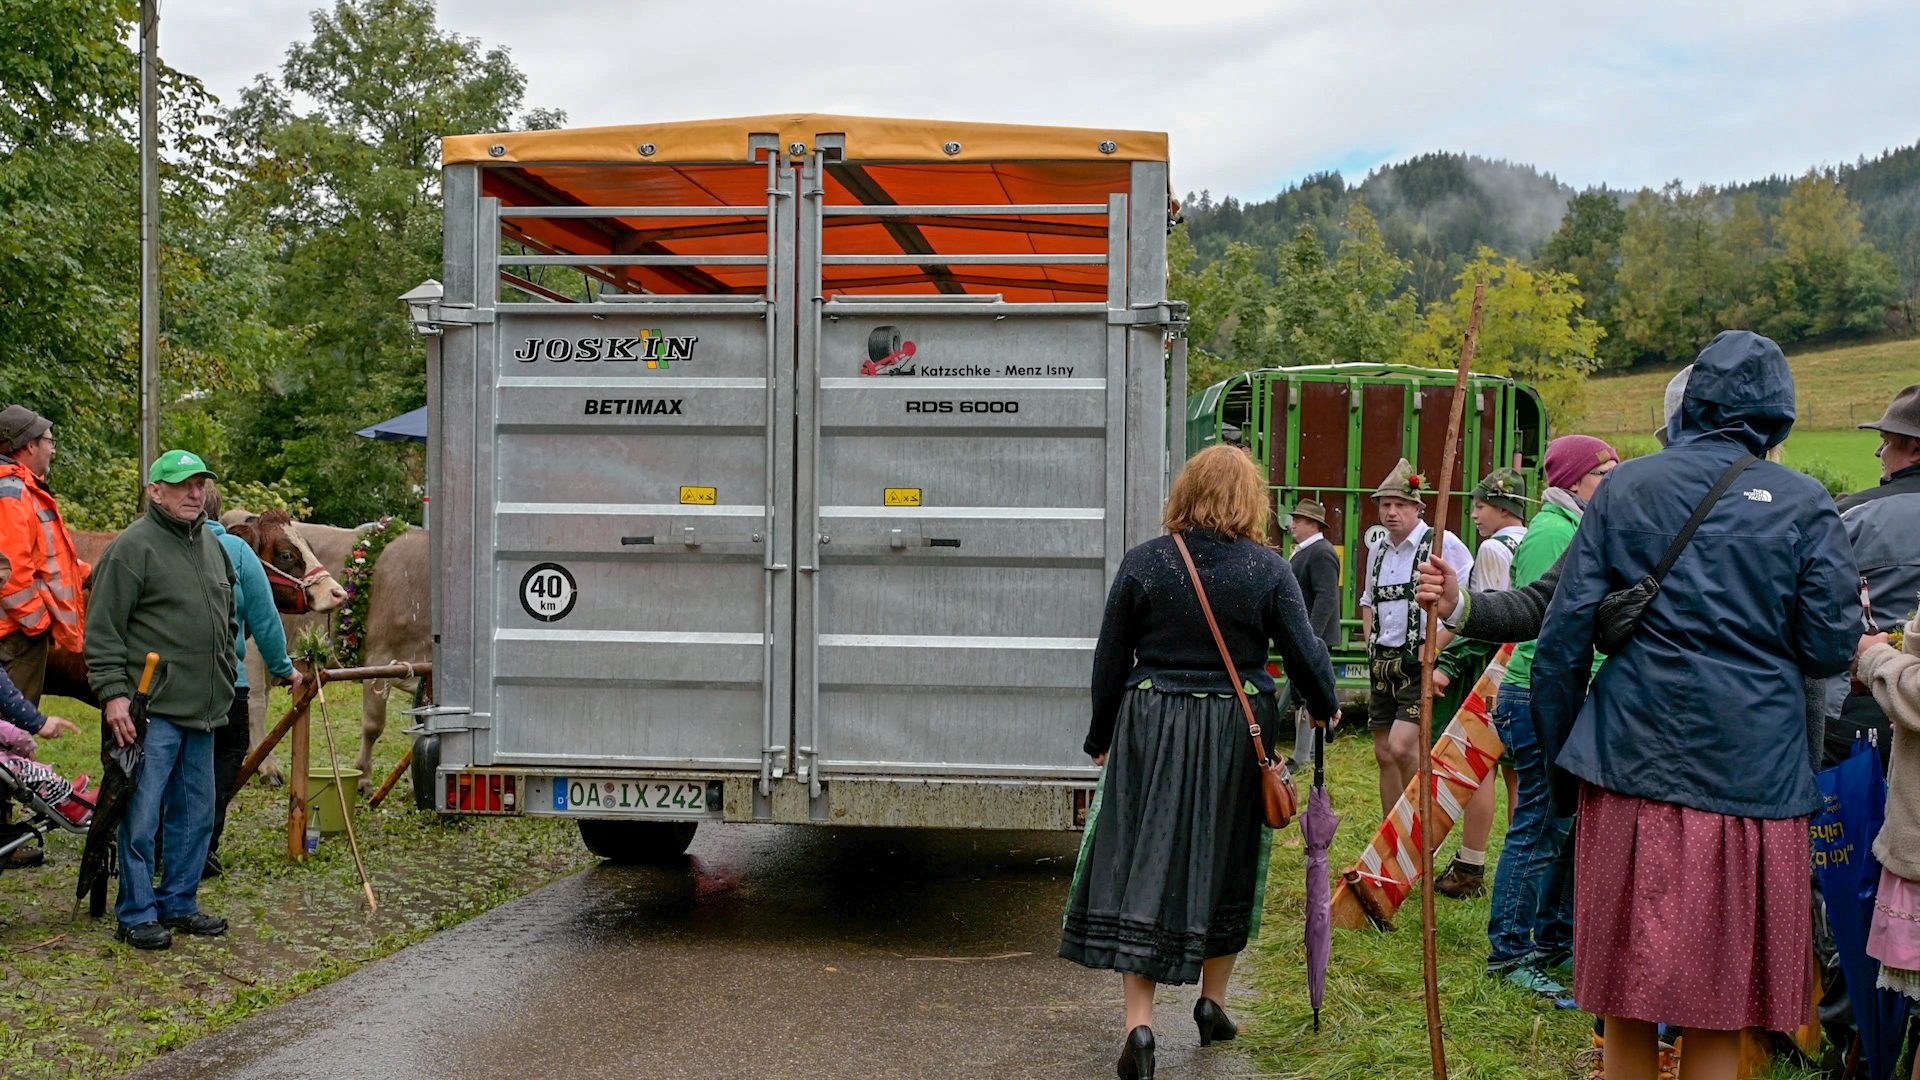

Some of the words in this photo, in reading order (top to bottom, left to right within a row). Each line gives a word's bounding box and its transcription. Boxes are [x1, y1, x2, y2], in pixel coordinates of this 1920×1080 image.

[513, 336, 699, 363] JOSKIN
[921, 364, 991, 377] Katzschke
[1005, 364, 1042, 376] Menz
[1046, 364, 1074, 378] Isny
[584, 399, 684, 416] BETIMAX
[906, 401, 954, 414] RDS
[959, 401, 1019, 414] 6000
[530, 575, 562, 598] 40
[540, 600, 556, 611] km
[569, 782, 601, 807] OA
[619, 783, 650, 808] IX
[655, 783, 702, 809] 242
